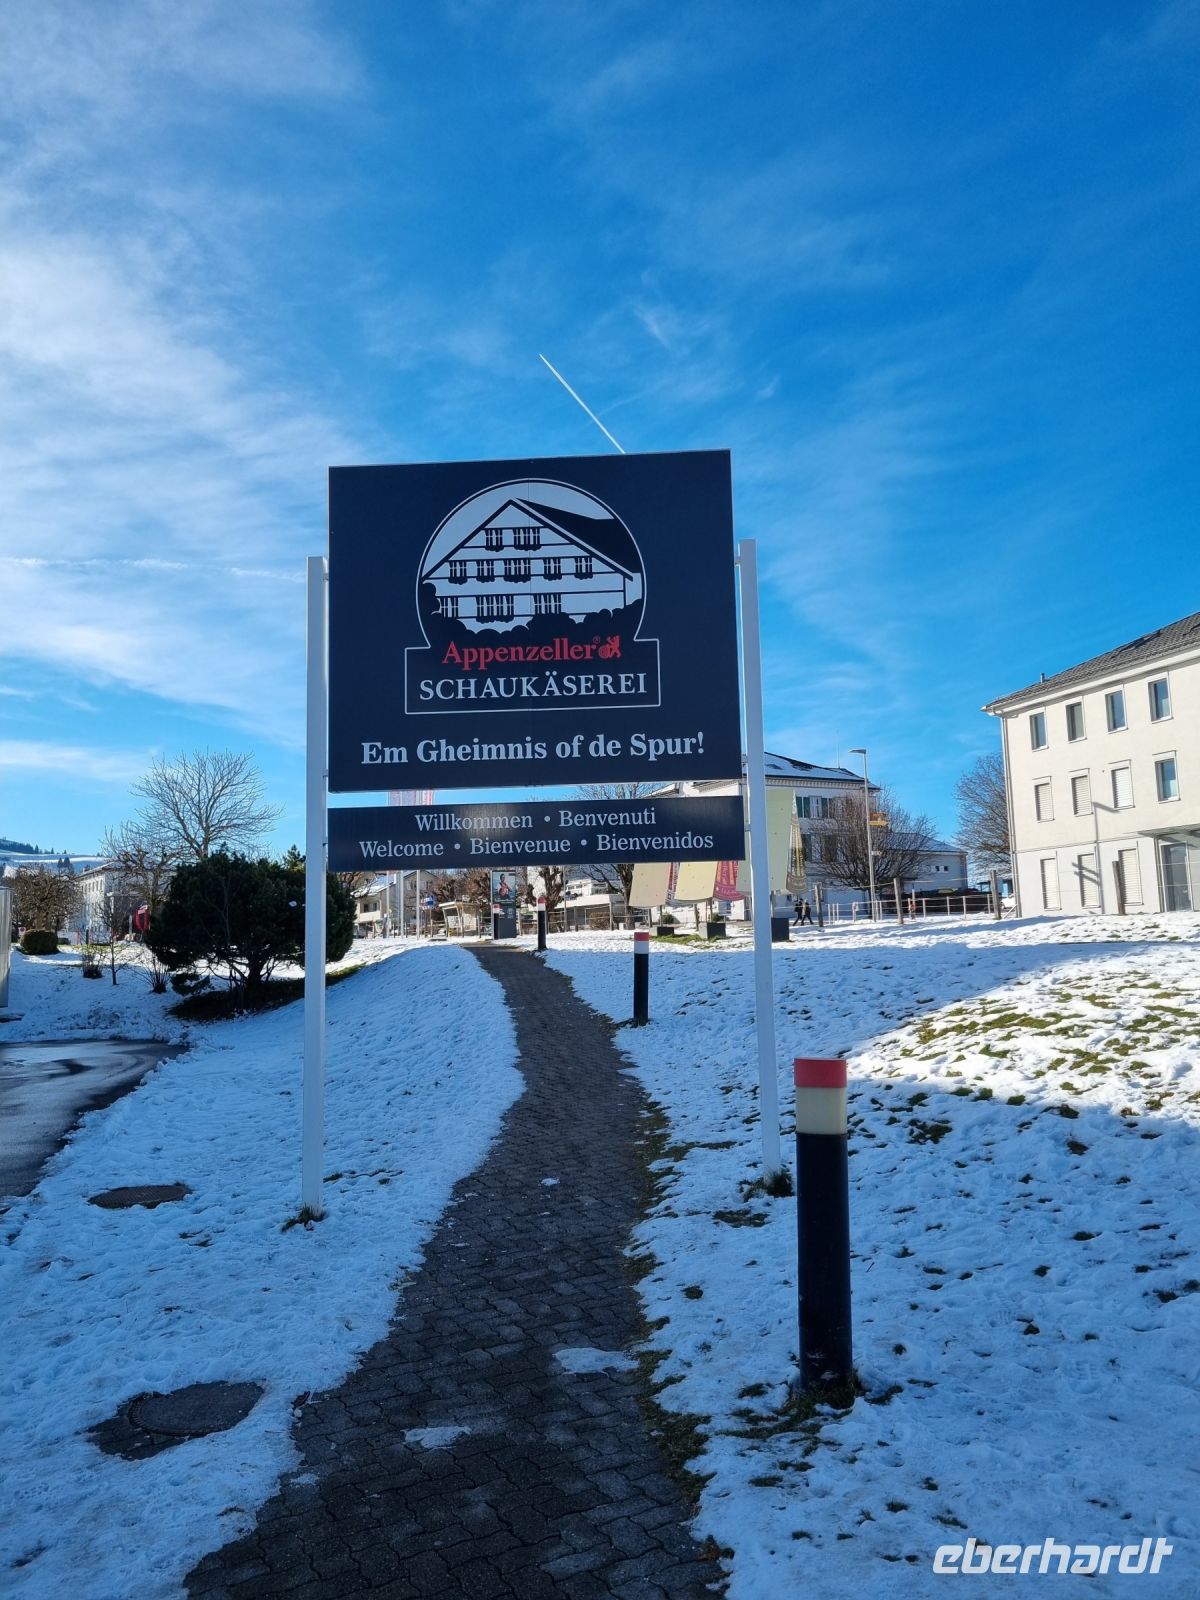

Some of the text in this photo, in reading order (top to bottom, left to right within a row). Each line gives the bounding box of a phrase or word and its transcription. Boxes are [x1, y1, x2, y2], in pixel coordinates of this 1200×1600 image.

[419, 671, 647, 700] SCHAUKÄSEREI
[361, 732, 704, 765] Em Gheimnis of de Spur!
[414, 808, 657, 832] Willkommen Benvenuti
[358, 831, 714, 858] Welcome Bienvenue Bienvenidos
